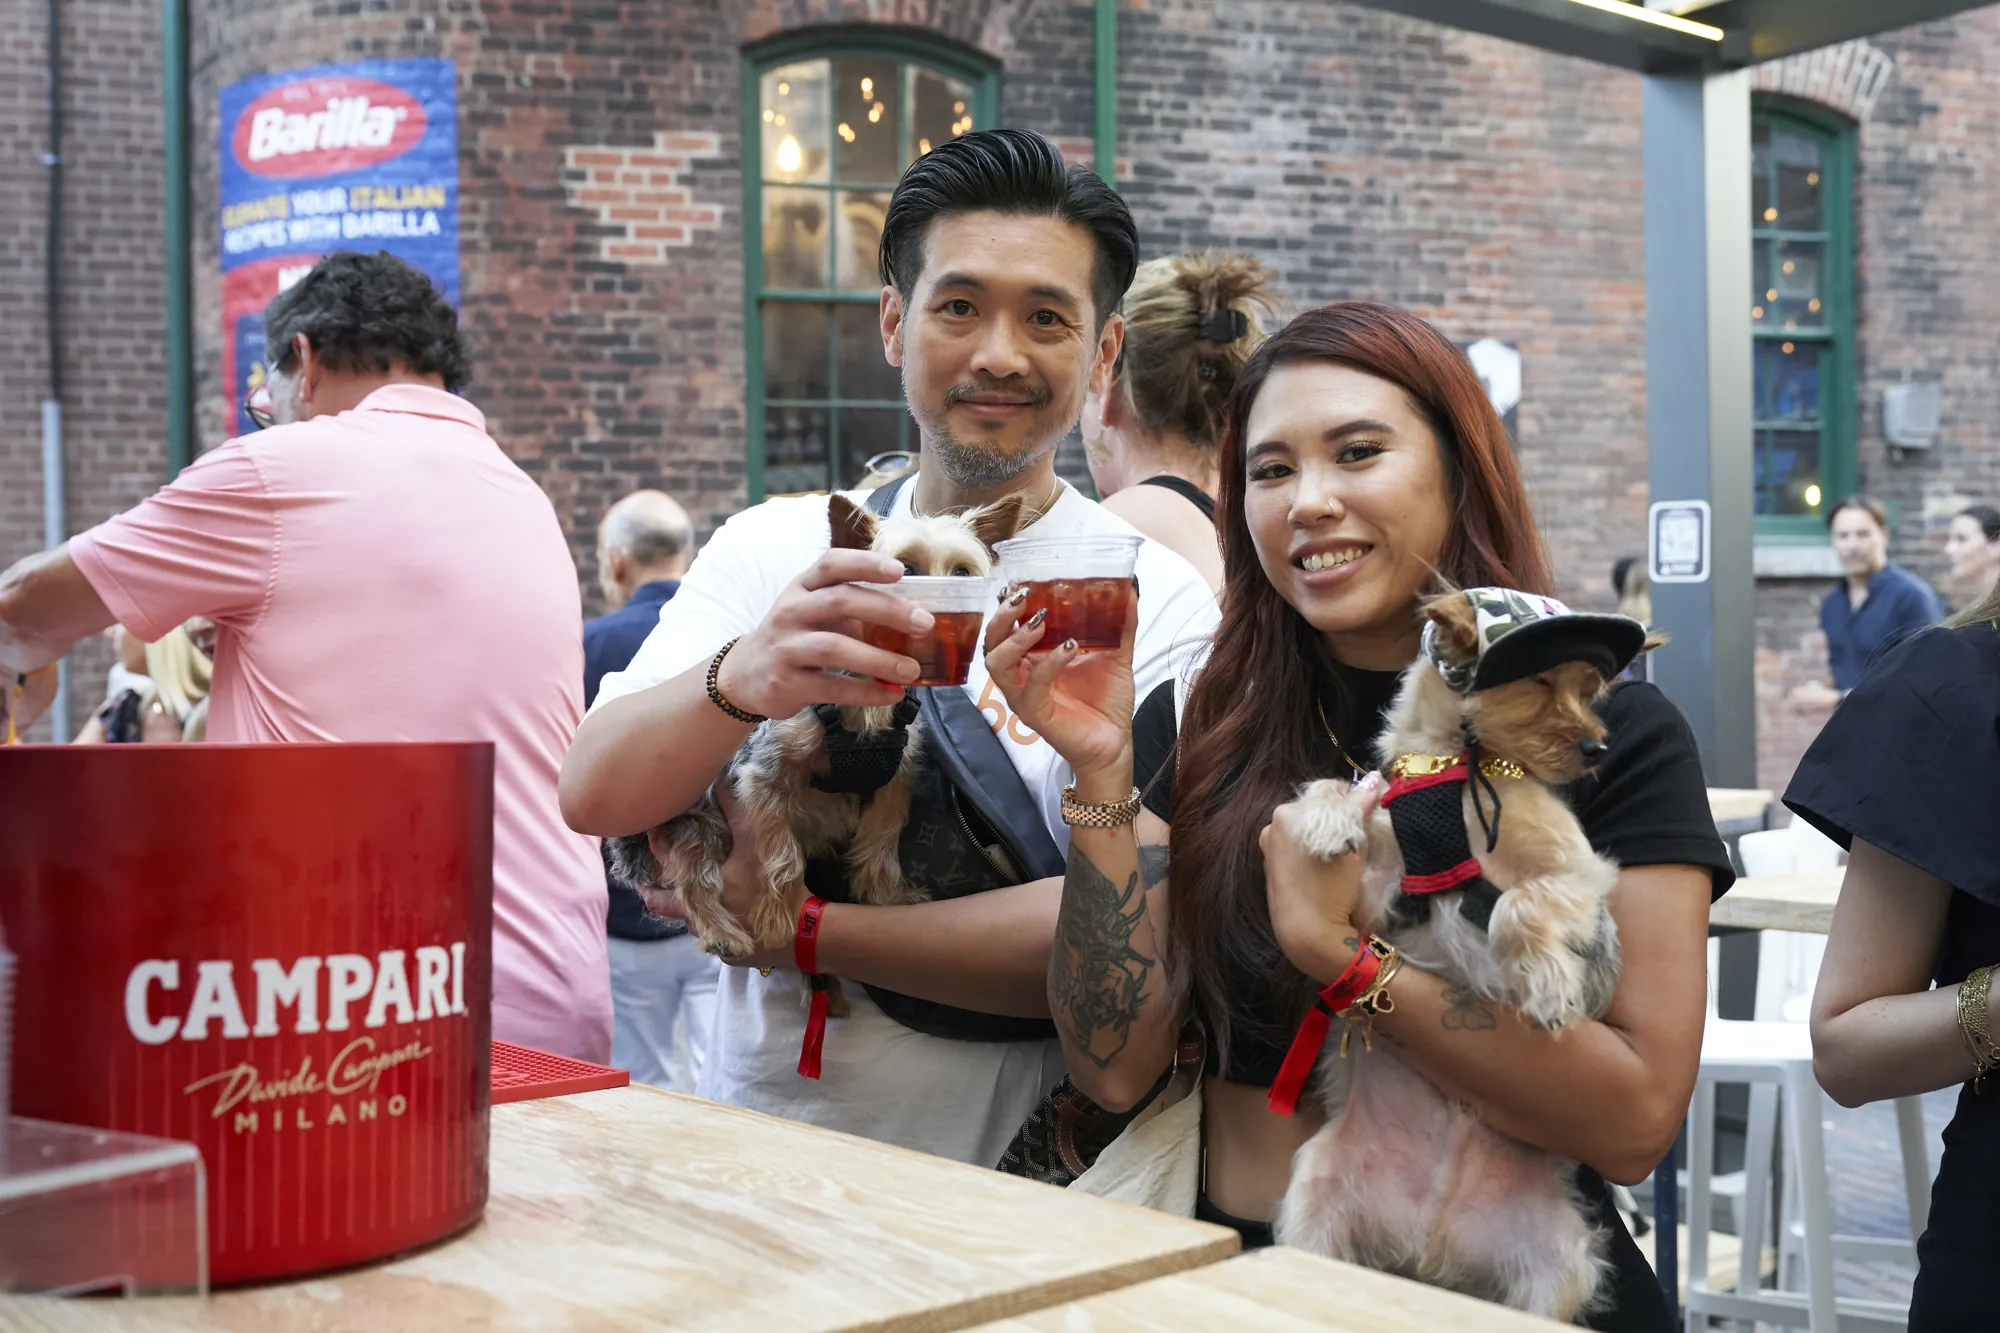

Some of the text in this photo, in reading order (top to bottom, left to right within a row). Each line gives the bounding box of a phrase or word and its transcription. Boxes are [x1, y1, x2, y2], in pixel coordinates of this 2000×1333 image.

[249, 97, 396, 160] Barilla
[291, 187, 348, 215] YOUR
[350, 184, 446, 210] ITALIAN
[342, 211, 440, 239] BARILLA
[125, 942, 466, 1044] CAMPARI
[183, 1029, 433, 1119] Davide Campari
[234, 1095, 407, 1135] MILANO
